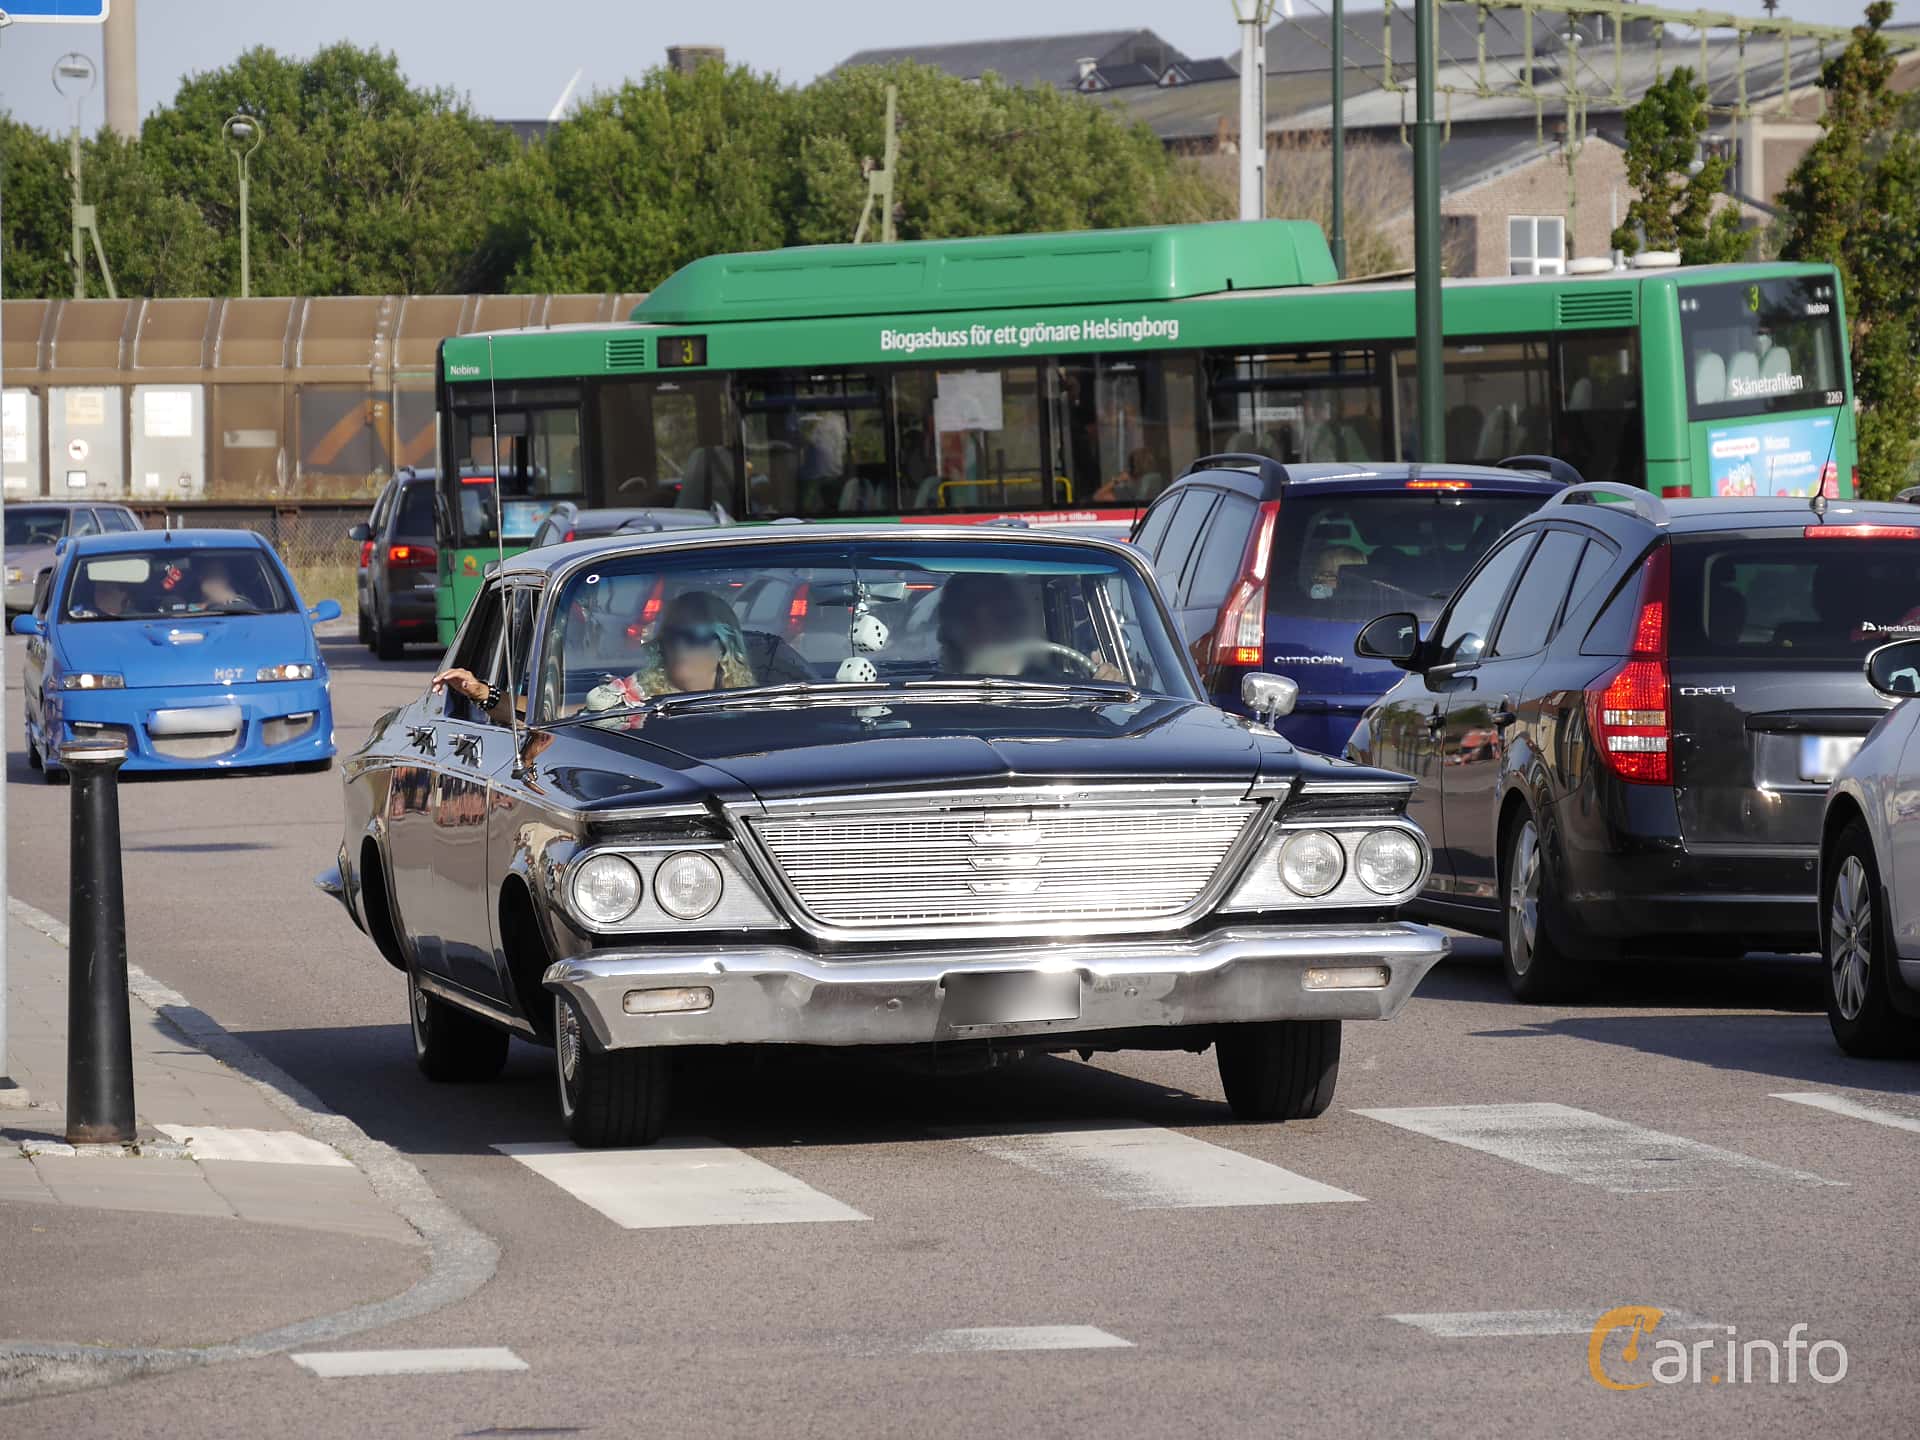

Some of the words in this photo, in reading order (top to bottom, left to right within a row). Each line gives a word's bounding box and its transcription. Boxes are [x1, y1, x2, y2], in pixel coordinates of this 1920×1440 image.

[1749, 284, 1760, 312] 3
[880, 326, 969, 352] Biogasbuss
[970, 324, 993, 346] för
[994, 326, 1018, 345] ett
[1019, 322, 1081, 347] grönare
[1083, 315, 1179, 342] Helsingborg
[681, 338, 694, 364] 3
[450, 363, 481, 376] Nobina
[1731, 373, 1804, 397] Skånetrafiken
[1878, 624, 1908, 632] Hedin
